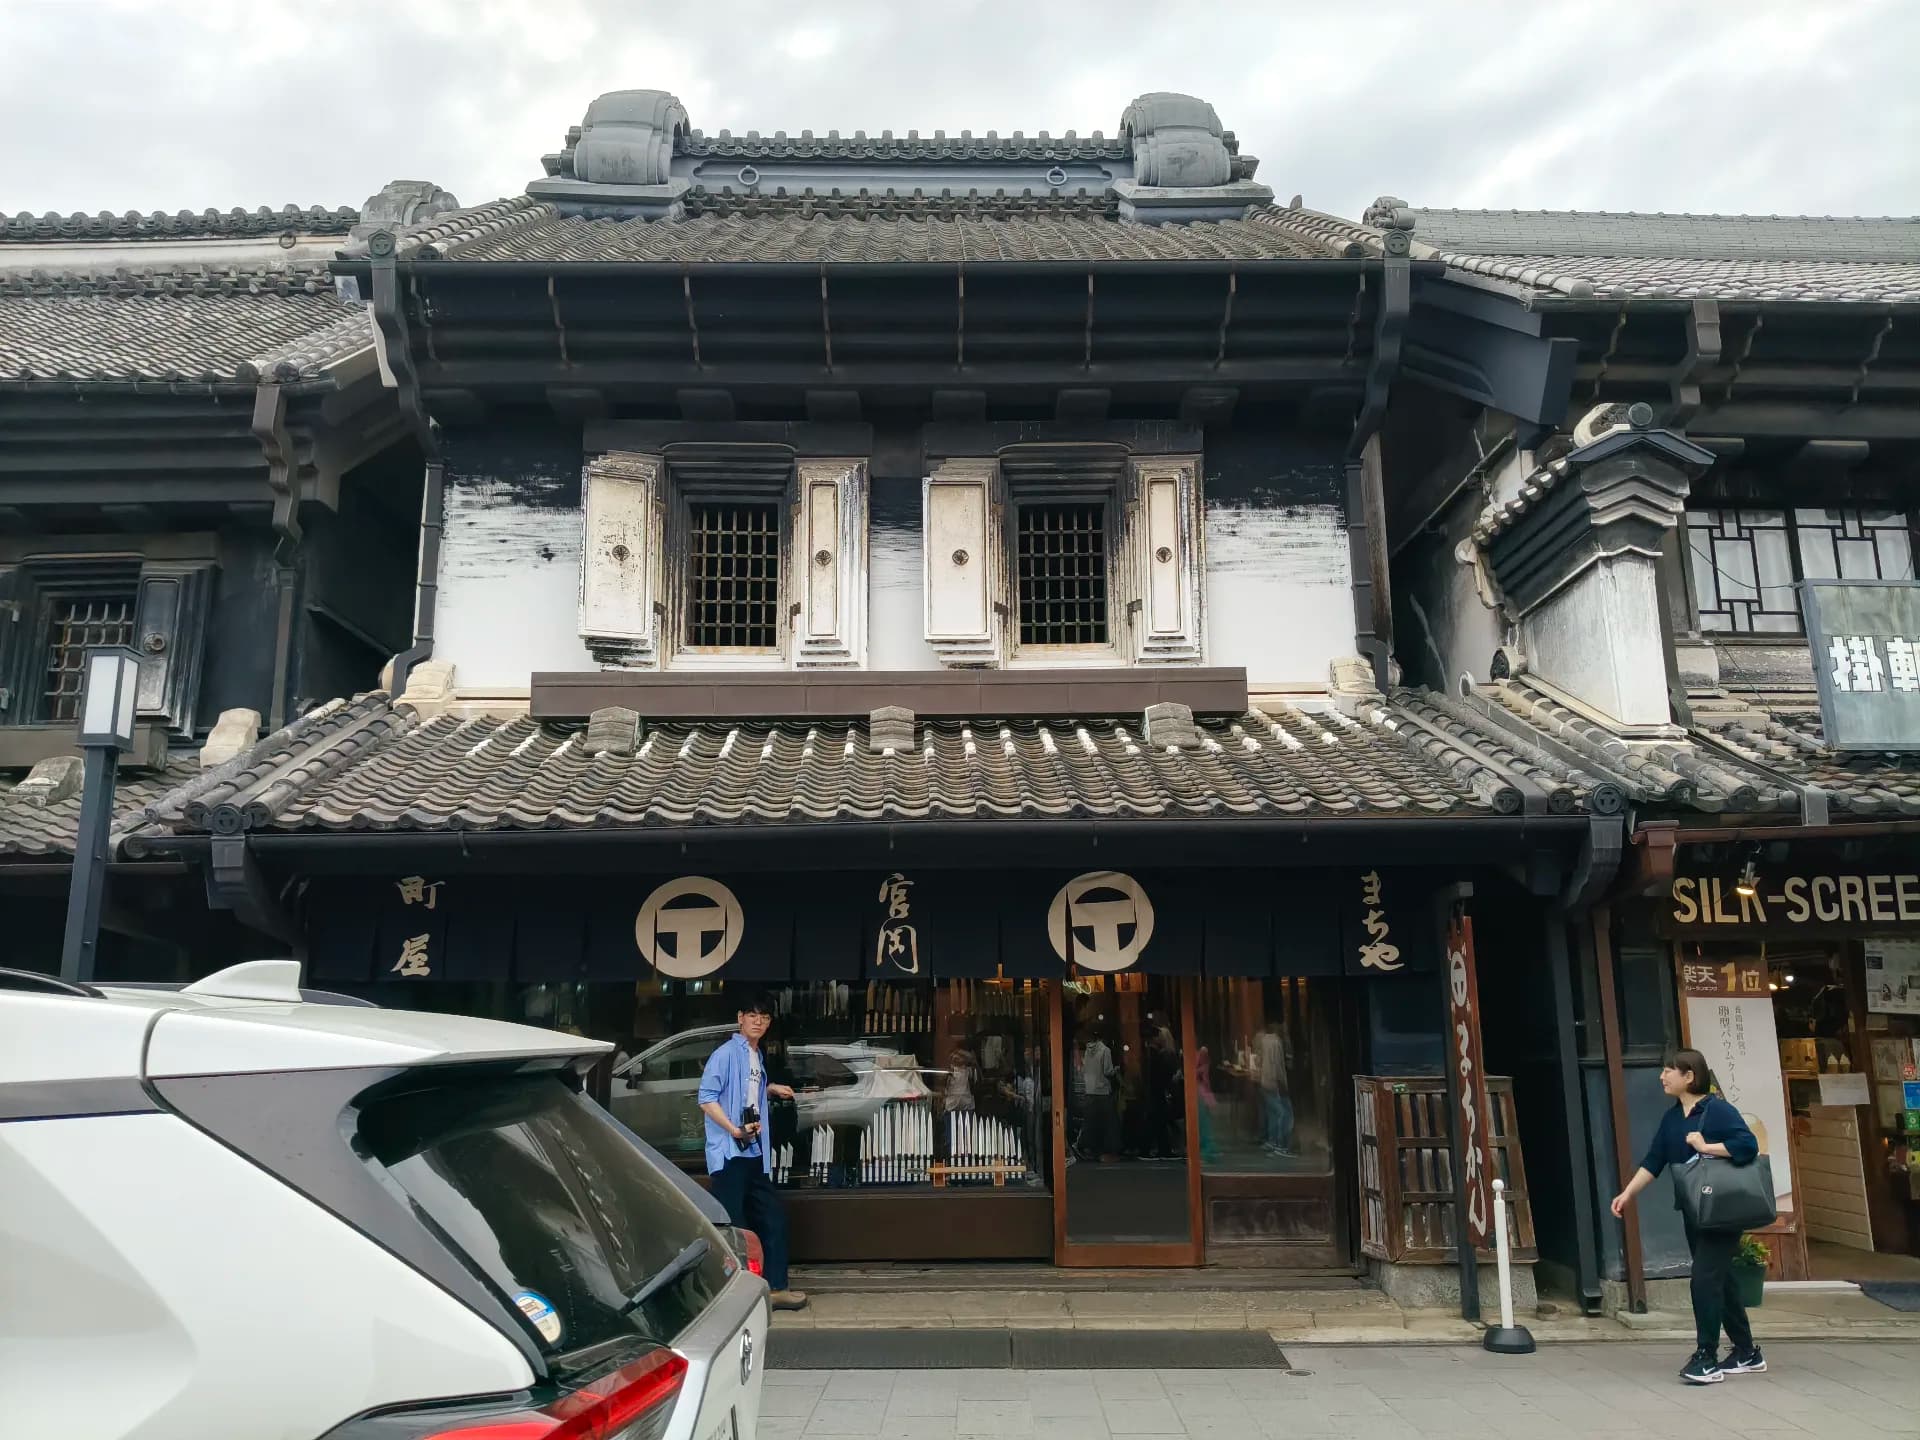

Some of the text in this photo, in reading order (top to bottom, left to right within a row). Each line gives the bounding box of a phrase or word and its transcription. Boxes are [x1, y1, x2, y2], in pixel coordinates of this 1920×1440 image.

[391, 875, 445, 977] 町屋
[1358, 869, 1404, 972] まちや
